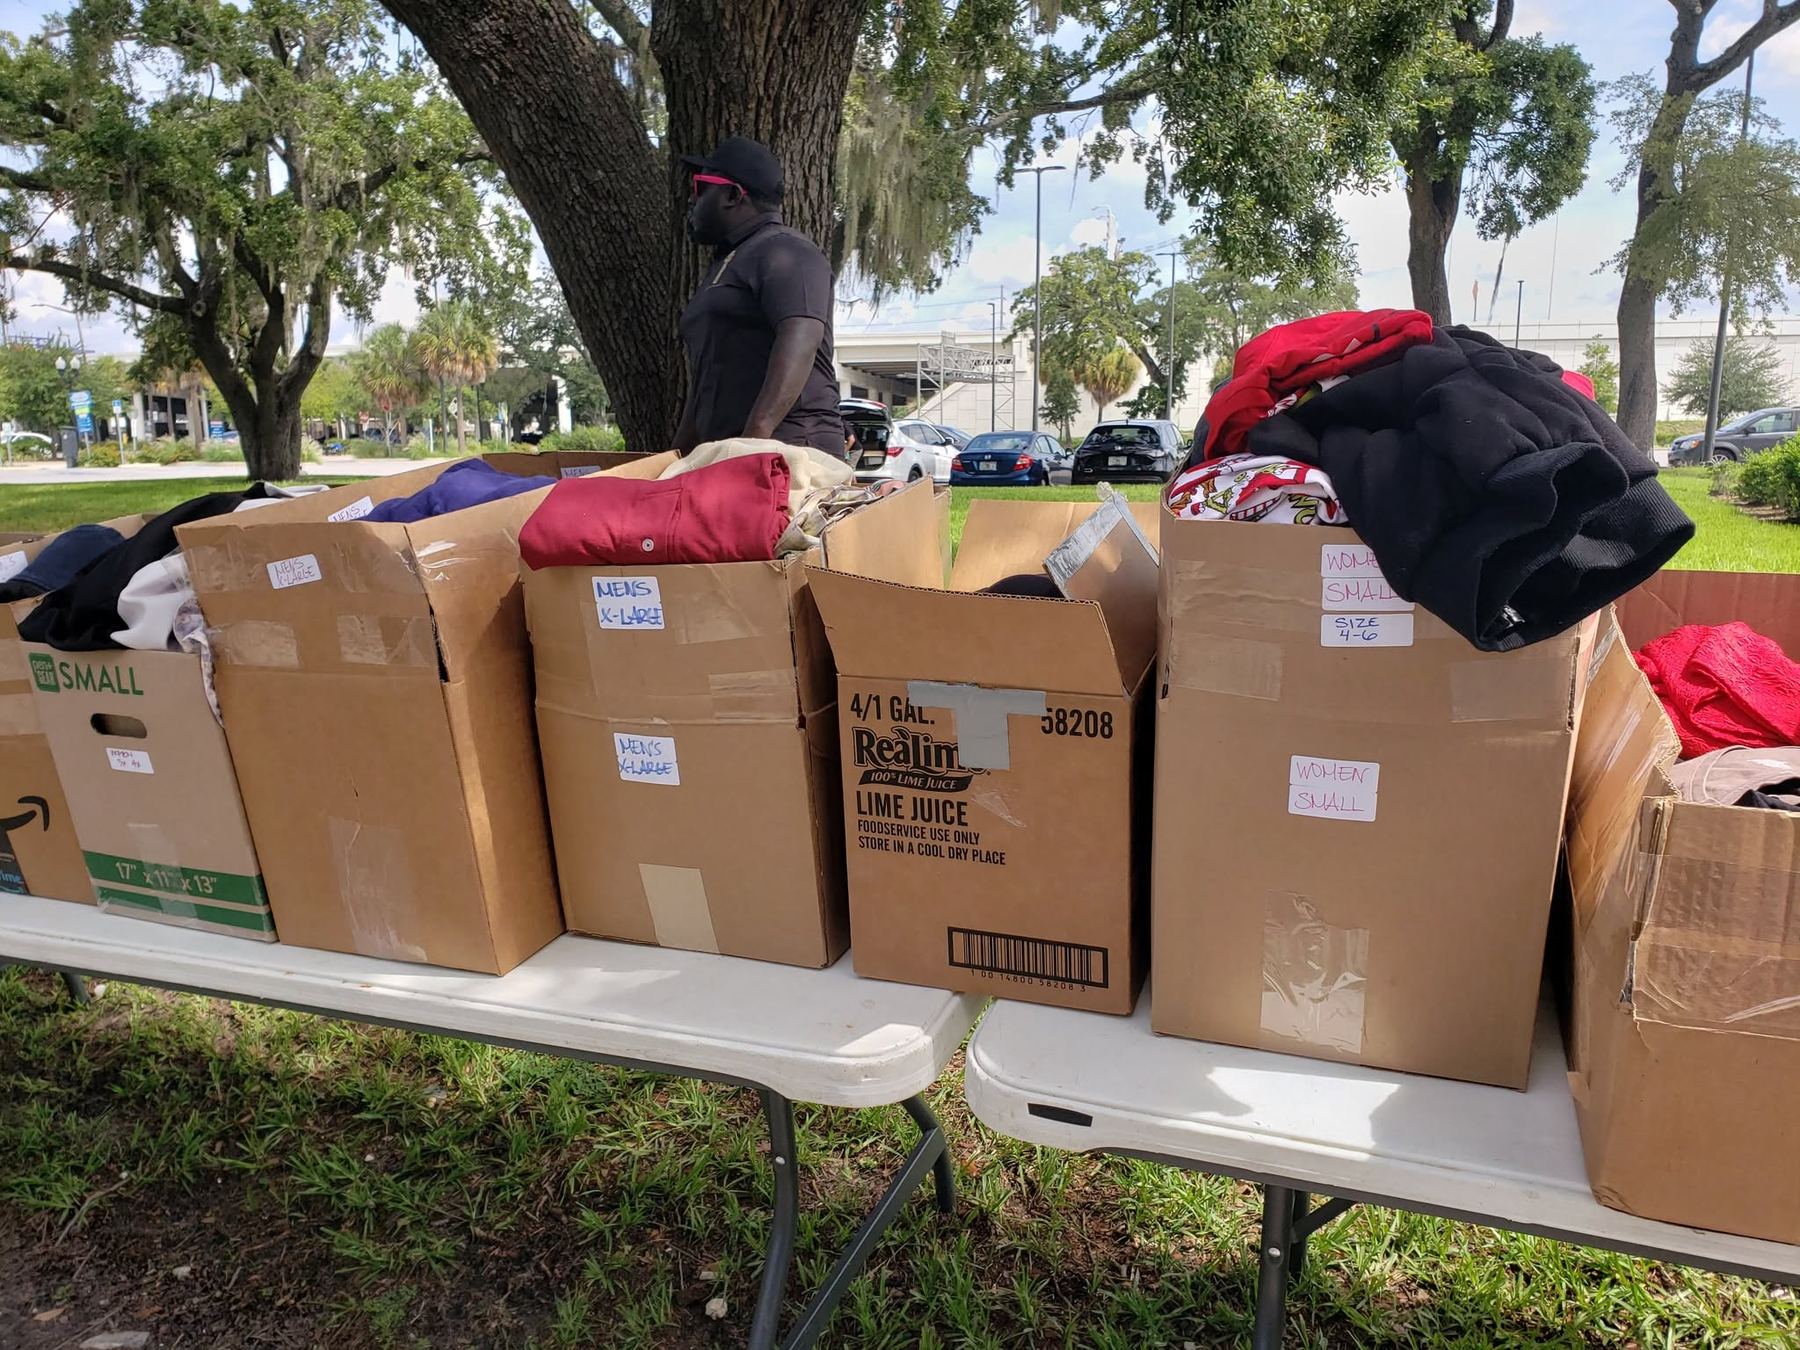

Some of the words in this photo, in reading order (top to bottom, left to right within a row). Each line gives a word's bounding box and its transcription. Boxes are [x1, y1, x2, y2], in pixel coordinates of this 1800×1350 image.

[1326, 551, 1380, 570] WOME
[596, 580, 652, 598] MENS
[1335, 617, 1380, 629] SIZE
[1339, 629, 1378, 641] 4-6
[59, 661, 144, 696] SMALL
[850, 692, 882, 722] 4/1
[889, 695, 935, 725] GAL.
[1041, 707, 1114, 740] 58208
[898, 773, 925, 788] LIME
[926, 777, 958, 790] JUICE
[1296, 761, 1371, 784] WOMEN
[856, 790, 905, 820] LIME
[910, 796, 969, 827] JUICE
[1294, 791, 1366, 812] SMALL
[858, 819, 927, 840] FOODSERVICE
[930, 827, 950, 842] USE
[953, 830, 980, 846] ONLY
[858, 835, 890, 852] STORE
[893, 839, 904, 854] IN
[907, 841, 915, 855] A
[918, 842, 946, 859] COOL
[948, 846, 969, 862] DRY
[972, 849, 1007, 866] PLACE
[193, 875, 217, 894] 13"
[1039, 979, 1074, 991] 58208
